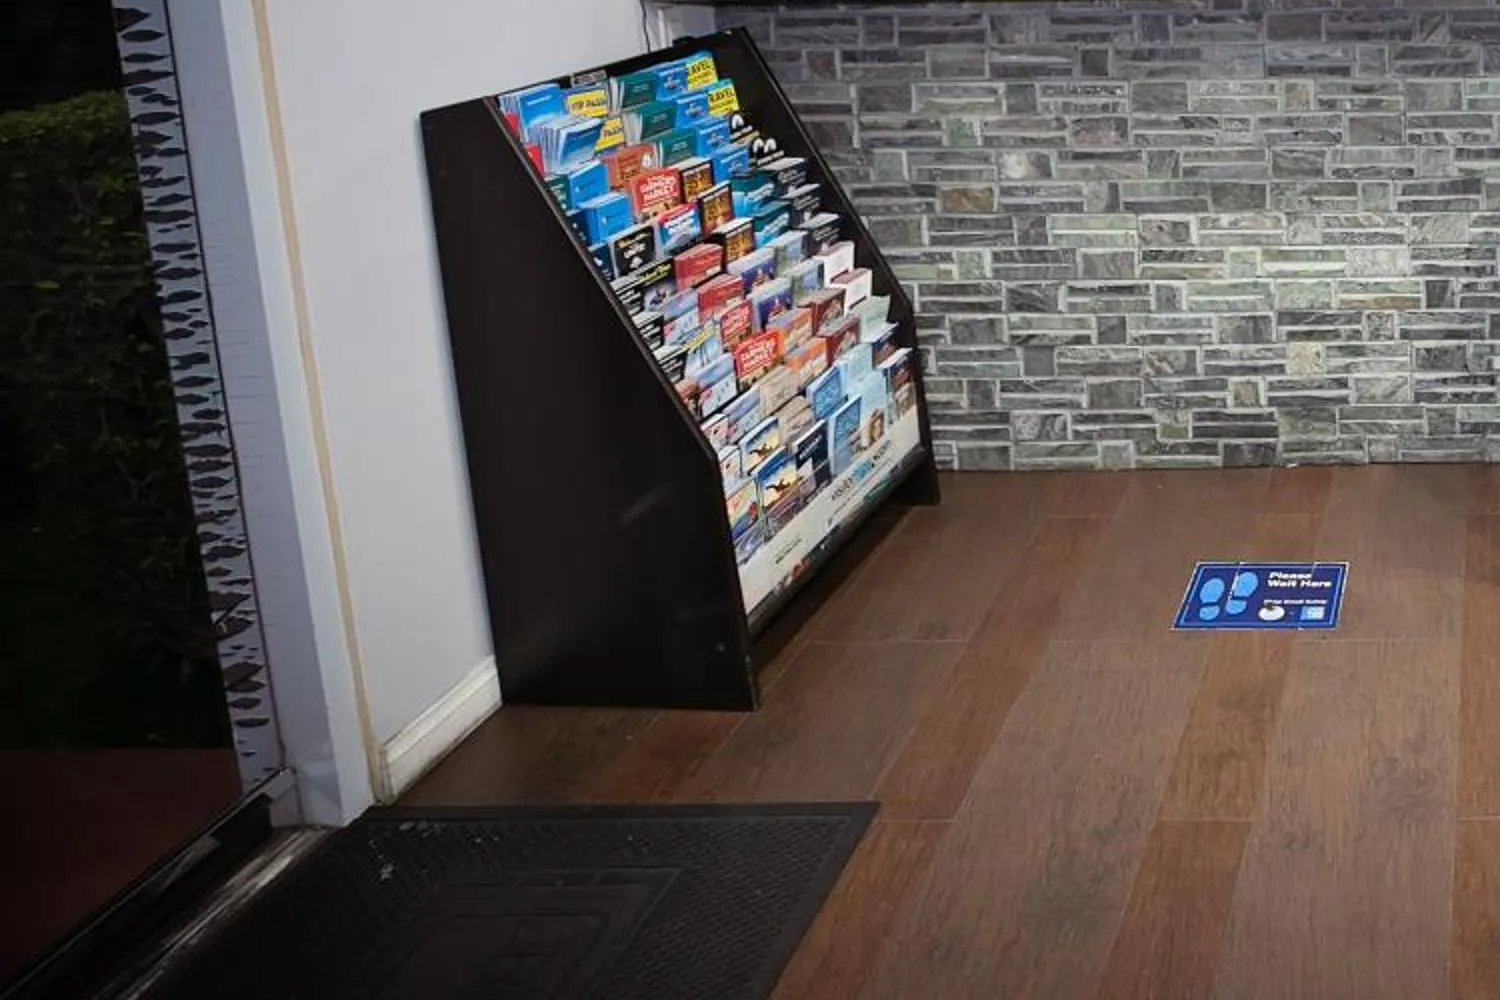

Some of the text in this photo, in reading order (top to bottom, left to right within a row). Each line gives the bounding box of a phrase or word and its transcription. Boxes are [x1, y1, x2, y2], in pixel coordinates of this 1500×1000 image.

[1269, 571, 1313, 579] Please
[1267, 580, 1333, 588] Wait Here
